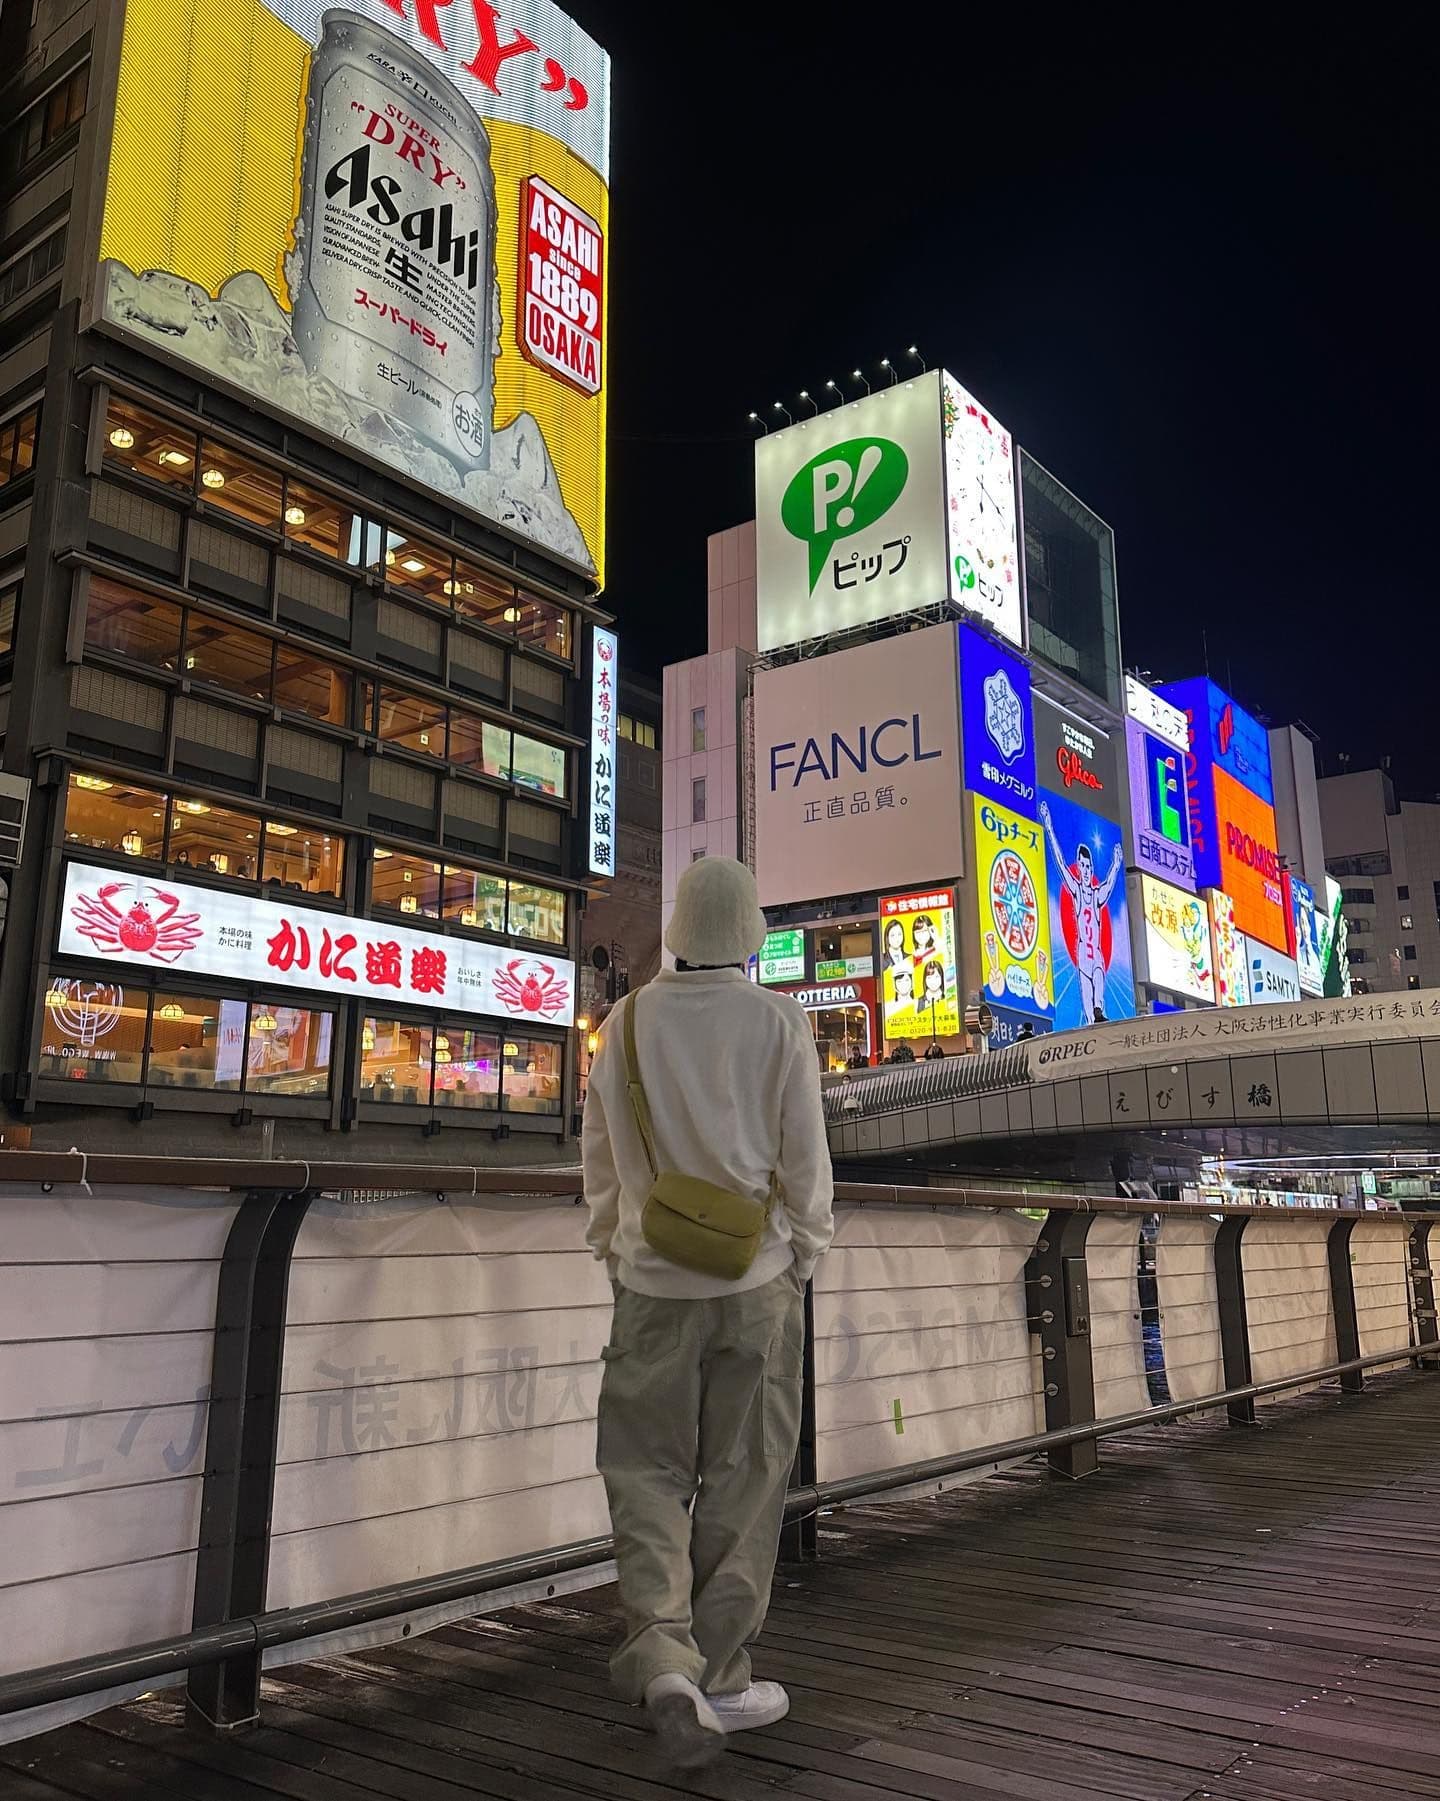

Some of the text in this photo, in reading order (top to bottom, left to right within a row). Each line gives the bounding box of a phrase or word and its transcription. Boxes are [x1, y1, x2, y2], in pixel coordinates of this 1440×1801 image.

[366, 53, 396, 75] KARA
[385, 104, 440, 153] SUPER
[325, 144, 478, 290] Asahi
[341, 209, 360, 221] SUPER
[361, 219, 374, 230] DRY
[375, 227, 381, 235] IS
[382, 232, 410, 252] BREWED
[411, 249, 428, 264] WITH
[530, 195, 598, 277] ASAHI
[384, 246, 424, 296] 生
[427, 272, 448, 292] UNDER
[549, 247, 582, 281] since
[363, 267, 382, 279] CRISP
[382, 277, 404, 293] TASTE
[403, 291, 419, 303] AND
[426, 283, 452, 306] MASTER
[426, 294, 439, 307] ING
[529, 253, 598, 334] 1889
[354, 288, 448, 356] スーパードライ
[529, 304, 598, 385] OSAKA
[377, 362, 419, 395] 生ビール
[455, 404, 483, 448] お酒
[833, 535, 911, 590] ピップ
[597, 667, 612, 746] 本場の味
[770, 714, 942, 792] FANCL
[1058, 747, 1103, 790] Glico
[982, 761, 1034, 800] 雪印メグミルク
[803, 785, 907, 823] 正直品質。
[1226, 821, 1281, 884] PROMISE
[218, 937, 253, 951] かに料理
[219, 926, 253, 939] 本場の味
[457, 967, 482, 979] おいしさ
[1266, 972, 1296, 1000] SAMTY
[1109, 1024, 1207, 1049] 一般社団法人
[1115, 1083, 1272, 1112] えびす橋
